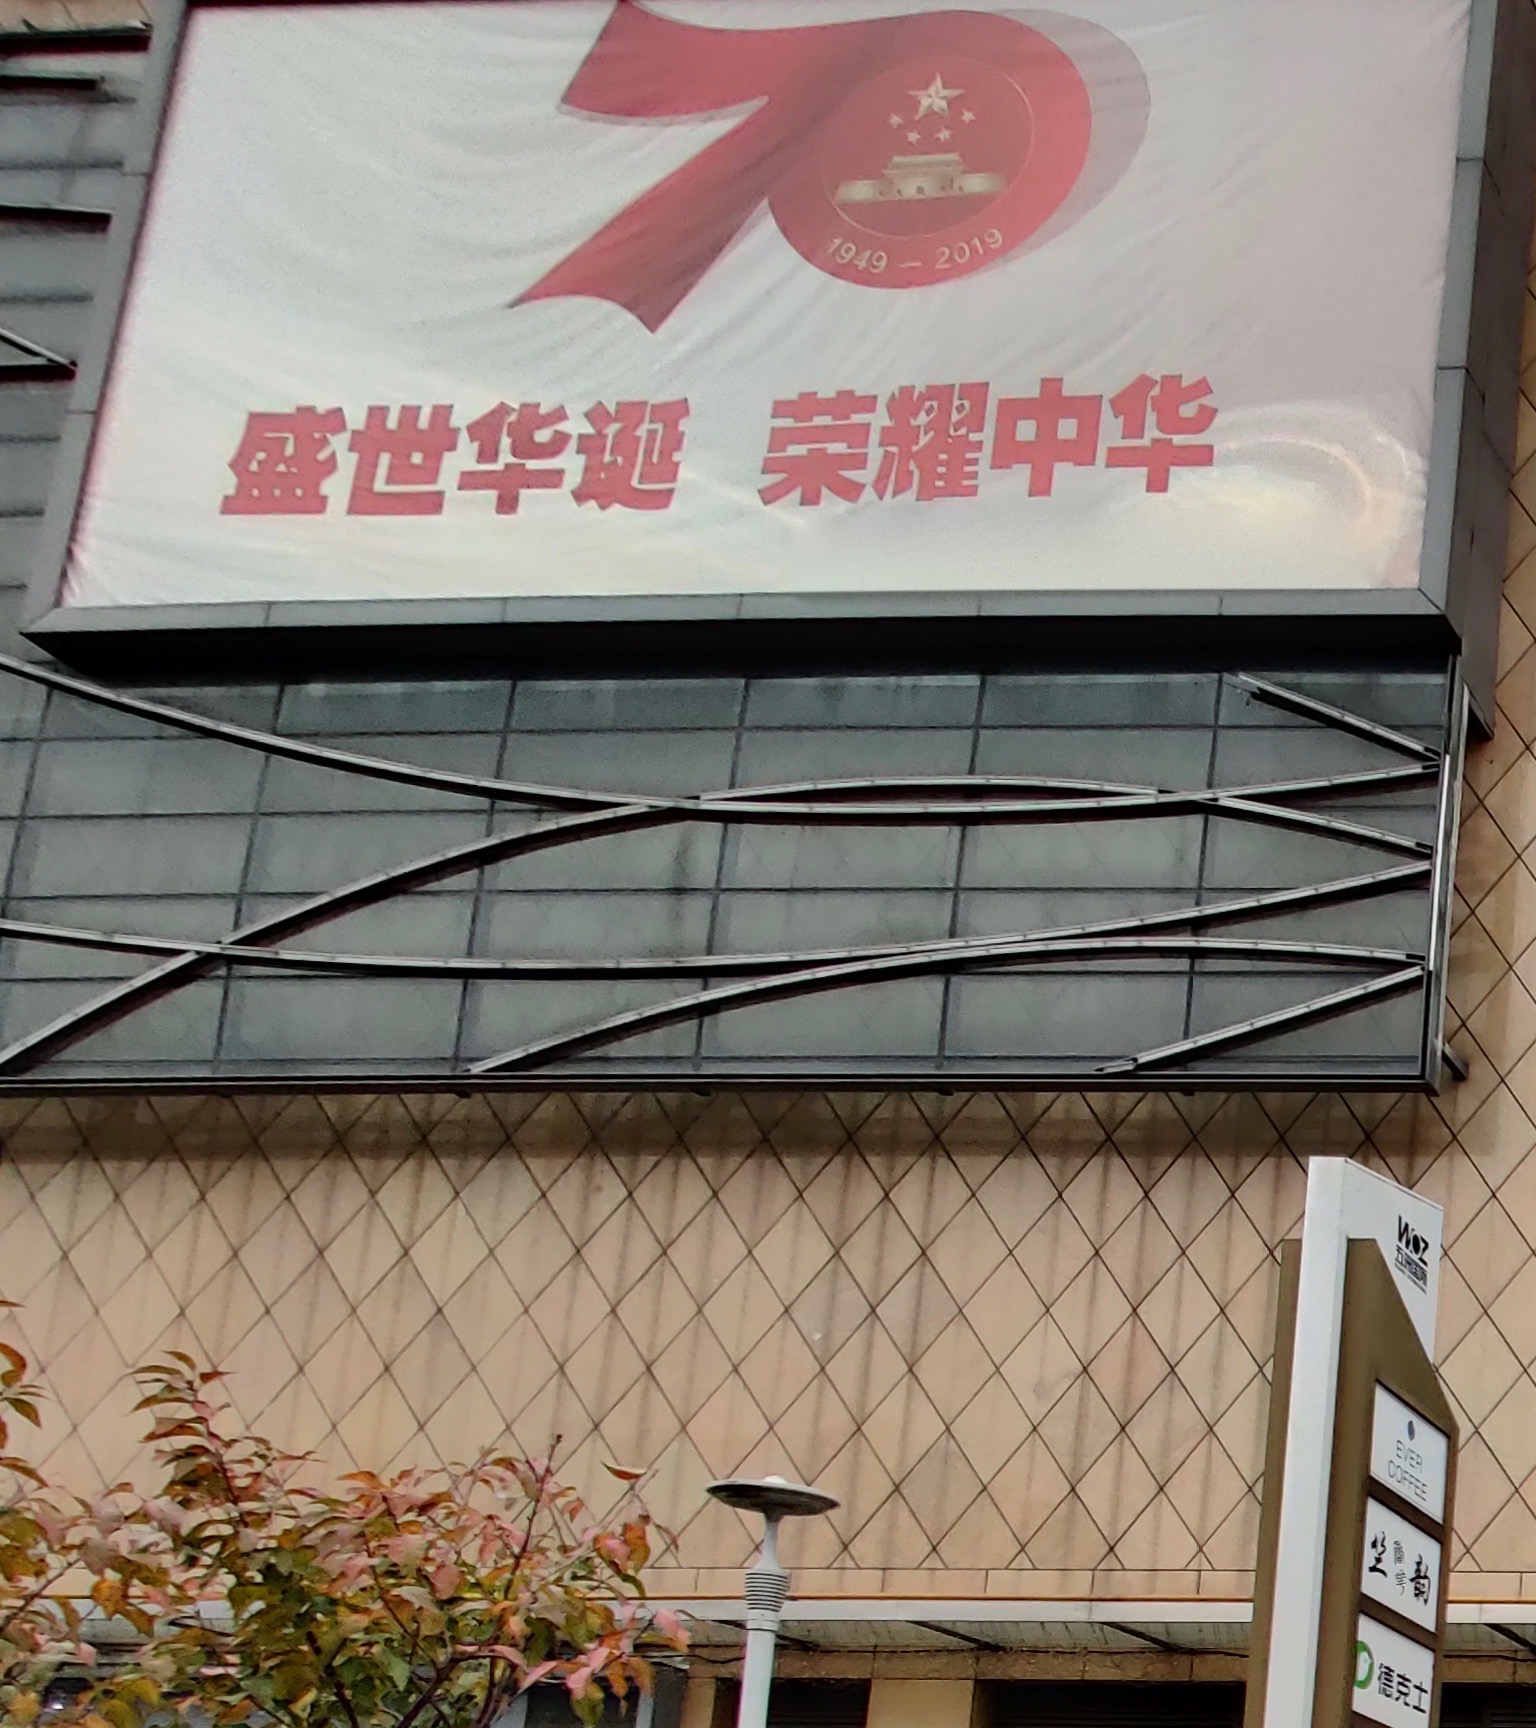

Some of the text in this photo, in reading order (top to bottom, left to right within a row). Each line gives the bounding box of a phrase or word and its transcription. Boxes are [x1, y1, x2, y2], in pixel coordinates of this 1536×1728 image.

[827, 236, 889, 275] 1949
[934, 227, 1005, 271] 2019
[757, 373, 1219, 507] 荣耀中华
[1395, 1439, 1424, 1474] EVER
[1388, 1460, 1428, 1502] COFFEE
[1377, 1662, 1429, 1714] 德克士
